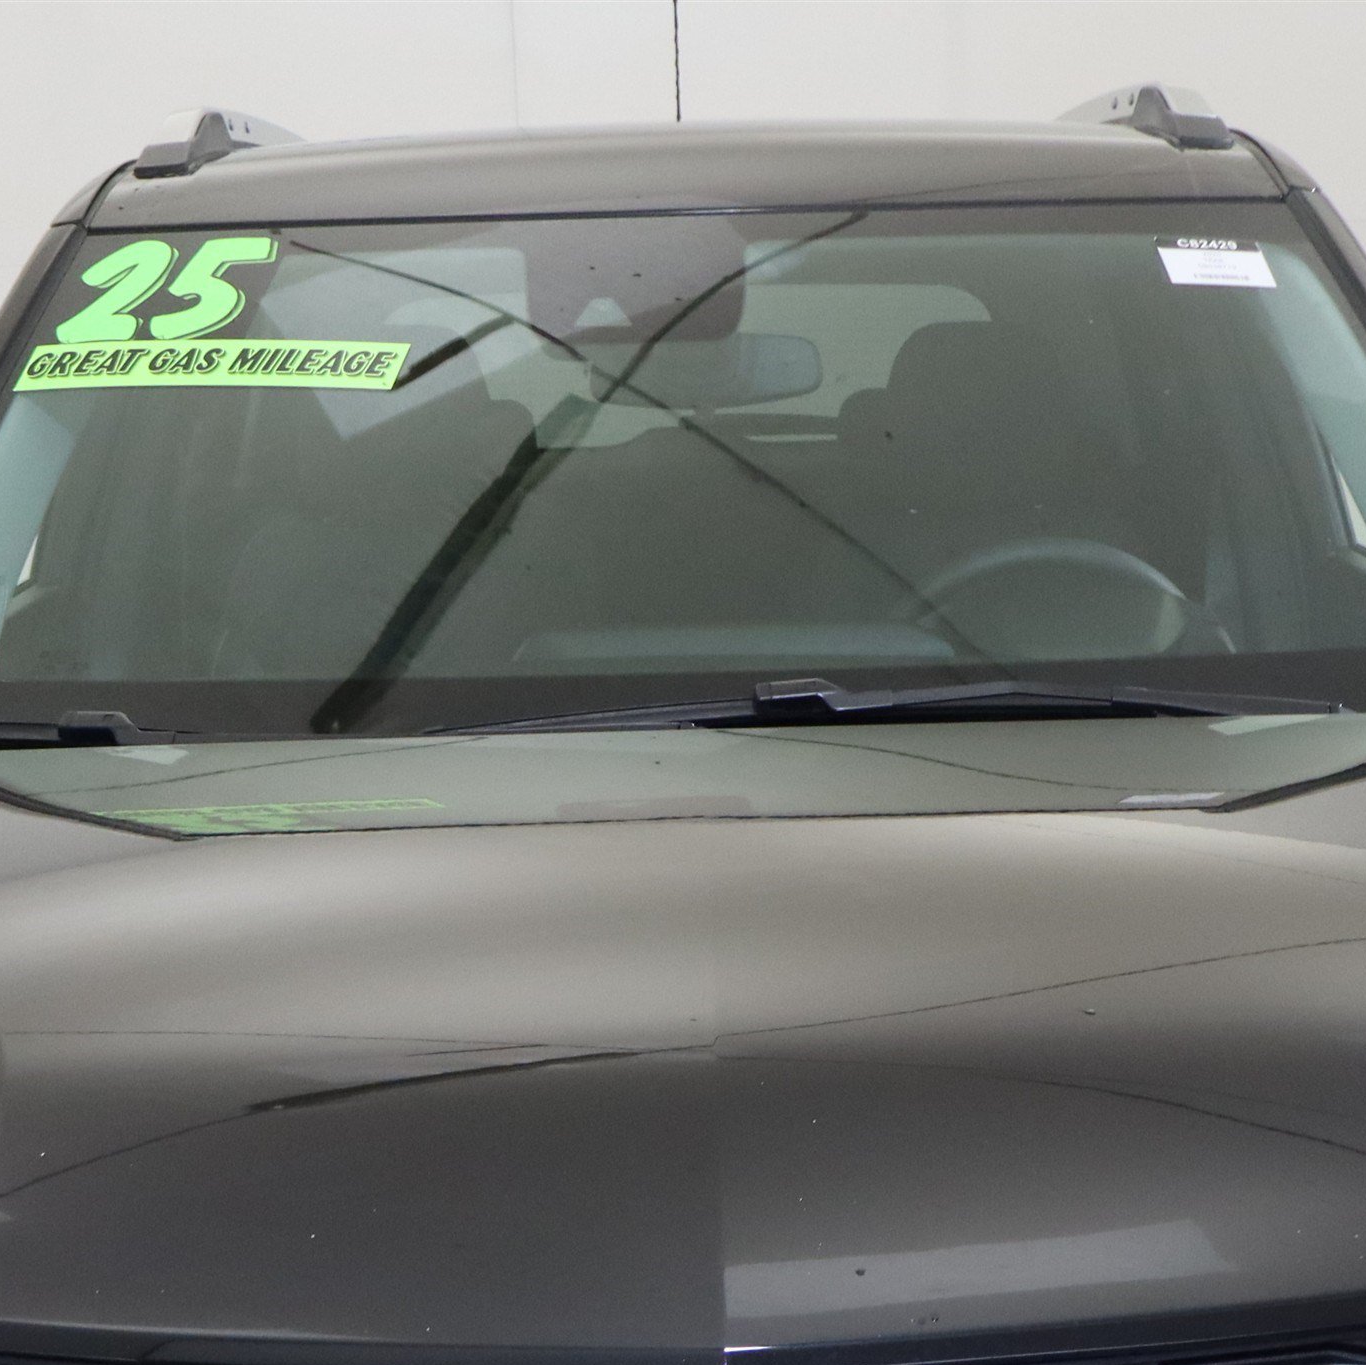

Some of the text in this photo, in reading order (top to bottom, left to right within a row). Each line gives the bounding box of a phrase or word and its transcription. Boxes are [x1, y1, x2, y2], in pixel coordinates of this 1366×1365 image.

[55, 236, 279, 344] 25
[26, 347, 397, 379] GREAT GAS MILEAGE
